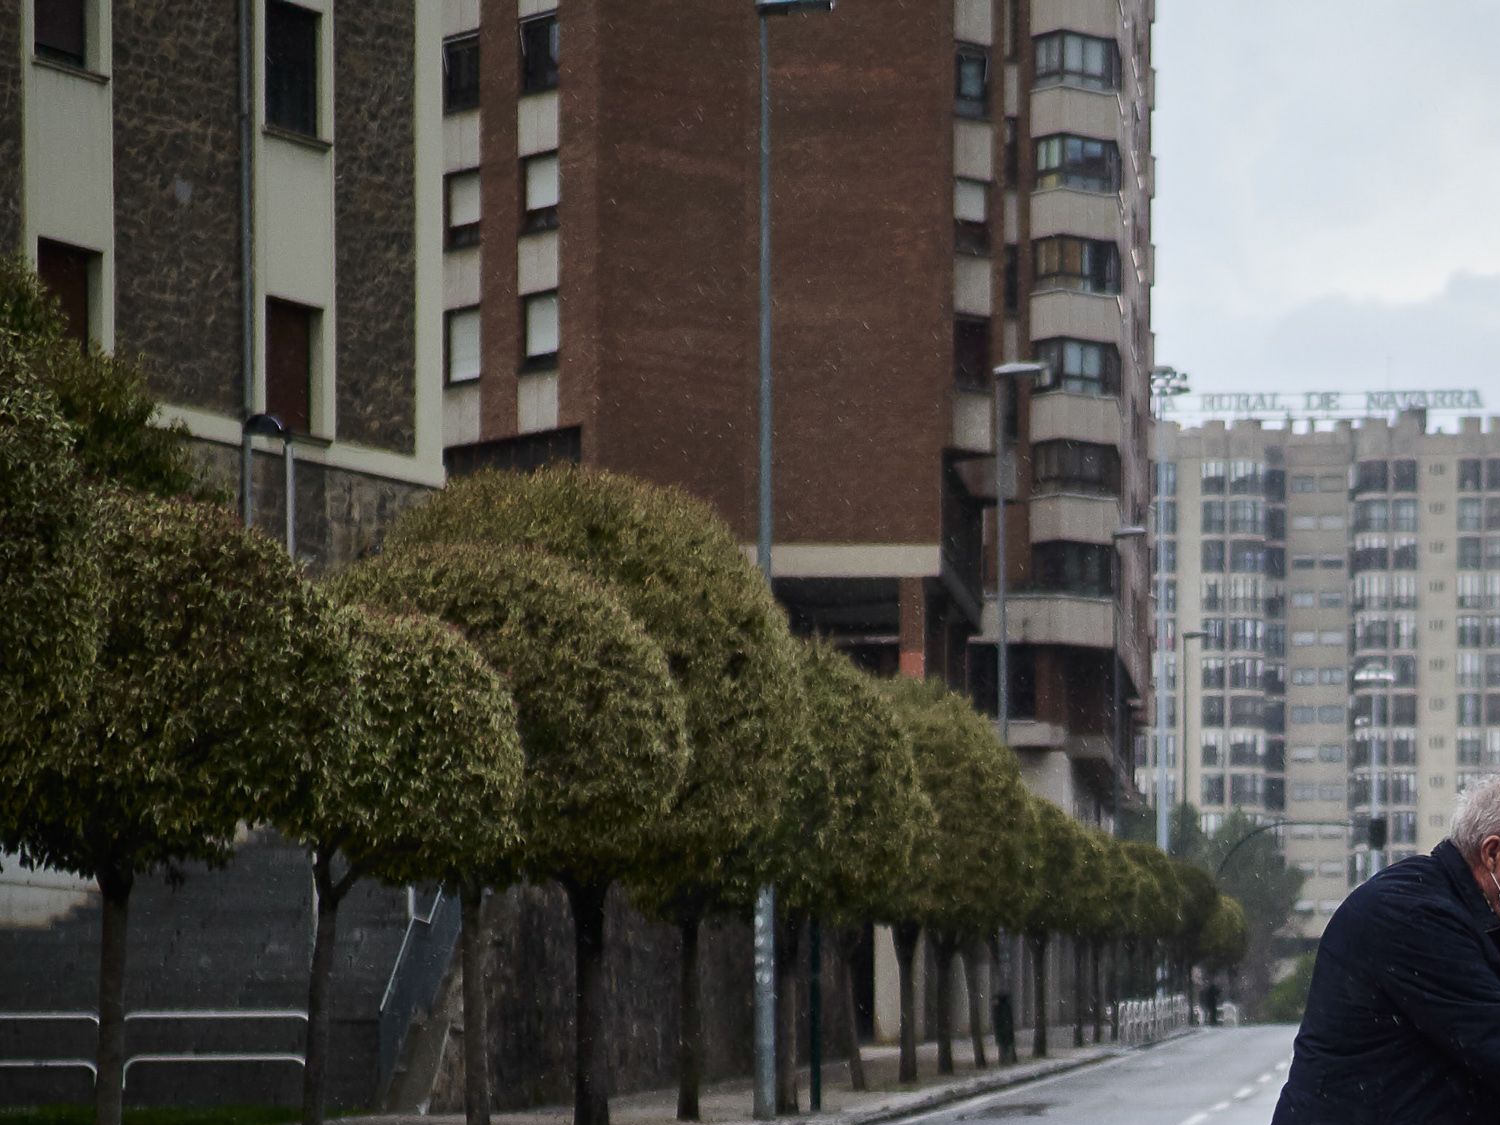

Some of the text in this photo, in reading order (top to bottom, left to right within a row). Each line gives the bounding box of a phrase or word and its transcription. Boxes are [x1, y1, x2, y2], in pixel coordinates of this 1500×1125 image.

[1201, 393, 1285, 412] RURAL
[1303, 391, 1341, 411] DE
[1365, 390, 1485, 410] NAVARRA
